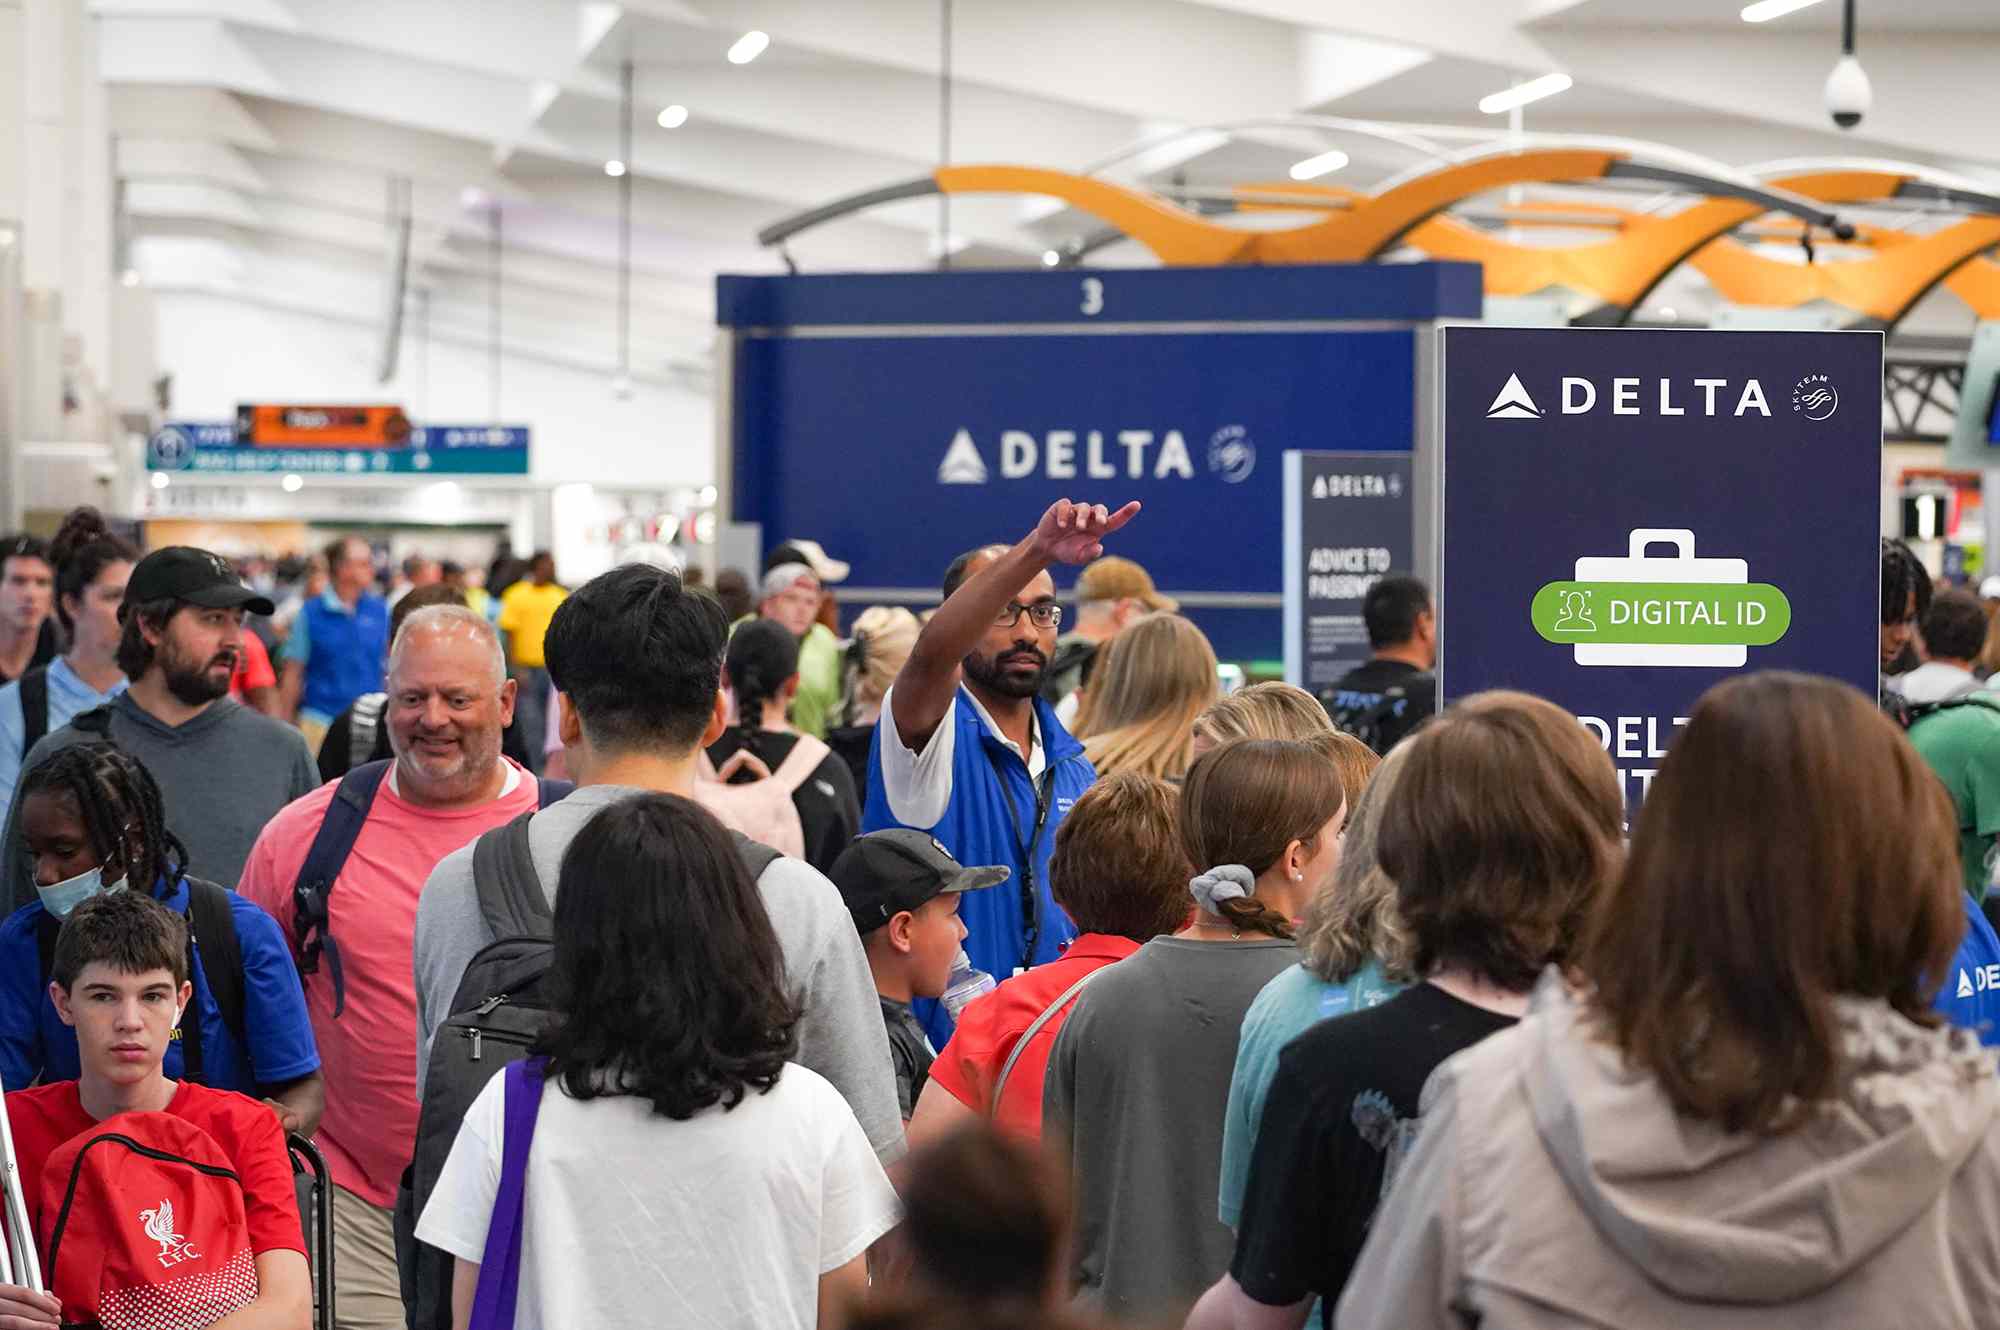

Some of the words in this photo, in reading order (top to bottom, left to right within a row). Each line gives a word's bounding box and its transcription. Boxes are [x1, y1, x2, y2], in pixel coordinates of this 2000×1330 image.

[1080, 277, 1104, 316] 3
[1561, 376, 1773, 418] DELTA
[1792, 374, 1829, 412] SKYTEAM
[999, 429, 1195, 480] DELTA
[1328, 474, 1387, 498] DELTA
[1609, 599, 1727, 626] DIGITAL
[1736, 602, 1767, 626] ID
